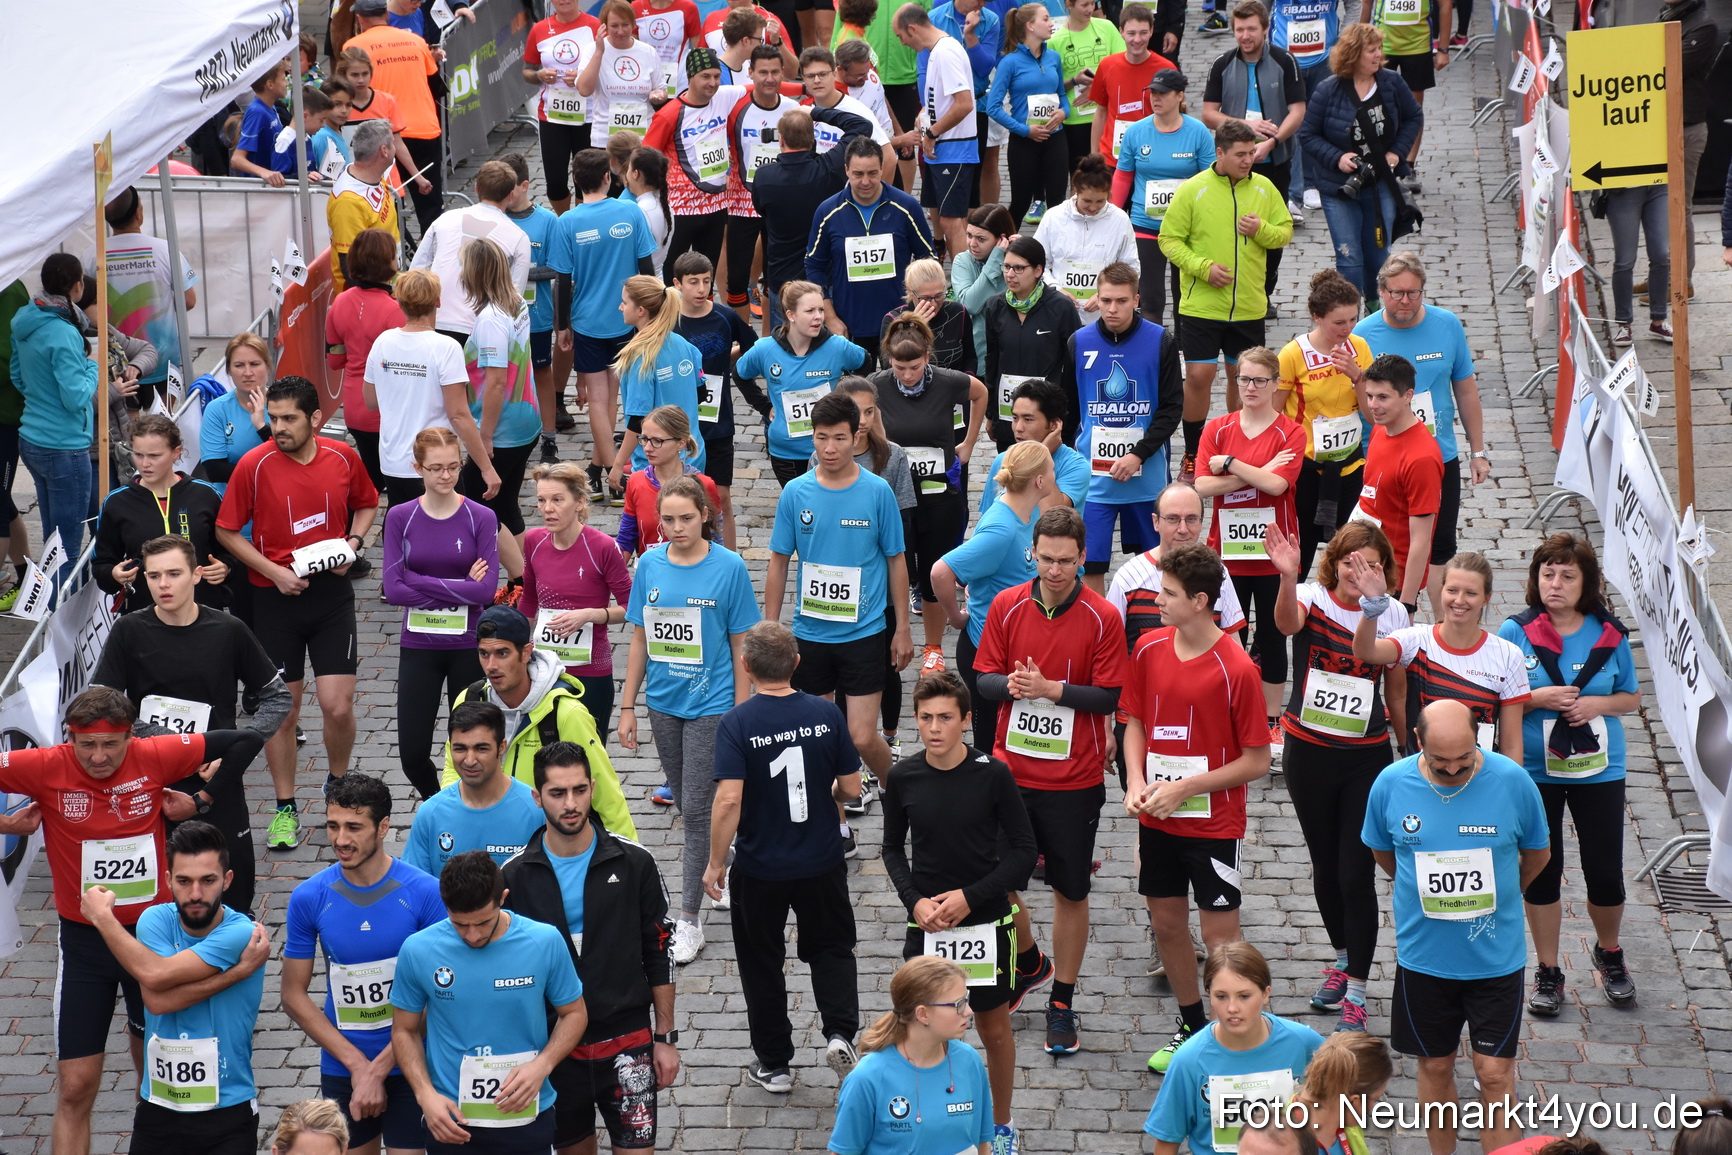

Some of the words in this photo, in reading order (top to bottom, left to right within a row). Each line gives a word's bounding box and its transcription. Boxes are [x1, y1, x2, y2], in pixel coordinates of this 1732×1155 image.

[1282, 3, 1329, 15] FIBALON
[1389, 0, 1416, 11] 5498
[1293, 31, 1320, 43] 8003
[195, 48, 237, 104] PARTL
[231, 12, 281, 77] Neumarkt
[376, 54, 420, 66] Kettenbach
[1517, 68, 1529, 88] swn
[1572, 67, 1666, 102] Jugend
[552, 99, 581, 112] 5160
[1603, 99, 1651, 126] lauf
[614, 114, 642, 126] 5047
[702, 148, 725, 165] 5030
[853, 249, 887, 265] 5157
[1066, 273, 1098, 287] 5007
[1084, 350, 1098, 369] 7
[1416, 352, 1443, 361] BOCK
[1309, 370, 1332, 382] MAX
[1609, 365, 1629, 391] swn
[1645, 382, 1653, 411] swn
[1322, 428, 1358, 450] 5177
[1098, 442, 1135, 458] 8003
[1233, 493, 1248, 501] DEHN
[302, 518, 317, 529] DEHN
[1228, 523, 1268, 540] 5042
[42, 545, 58, 576] swn
[308, 553, 348, 575] 5102
[809, 579, 850, 601] 5195
[24, 583, 41, 614] swn
[687, 597, 717, 608] BOCK
[803, 600, 830, 611] Mohamad
[831, 602, 856, 613] Ghasem
[425, 616, 447, 625] Natalie
[654, 623, 694, 642] 5205
[664, 646, 685, 654] Madlen
[669, 663, 704, 673] Neumarkter
[668, 671, 697, 680] Stadtlauf
[1466, 669, 1499, 681] NEUMARKT
[167, 704, 191, 713] BOCK
[1313, 689, 1363, 715] 5212
[1017, 711, 1063, 736] 5036
[1313, 715, 1340, 726] ANITA
[750, 734, 772, 749] The
[773, 730, 797, 747] way
[799, 726, 812, 738] to
[813, 723, 831, 738] go.
[1024, 739, 1051, 750] Andreas
[1568, 760, 1590, 769] Christa
[112, 776, 149, 793] NEUMARKTER
[769, 746, 808, 823] 1
[64, 804, 88, 812] NEU
[1458, 826, 1497, 834] BOCK
[113, 843, 136, 852] BOCK
[487, 845, 523, 854] BOCK
[93, 857, 147, 881] 5224
[1428, 870, 1484, 893] 5073
[1439, 898, 1477, 909] Friedhelm
[935, 940, 986, 961] 5123
[355, 967, 382, 977] BOCK
[494, 976, 534, 989] BOCK
[342, 979, 393, 1004] 5187
[360, 1008, 386, 1019] Ahmad
[166, 1045, 194, 1053] BOCK
[156, 1057, 206, 1083] 5186
[492, 1060, 518, 1069] BOCK
[1242, 1081, 1270, 1090] BOCK
[167, 1088, 191, 1099] Hamza
